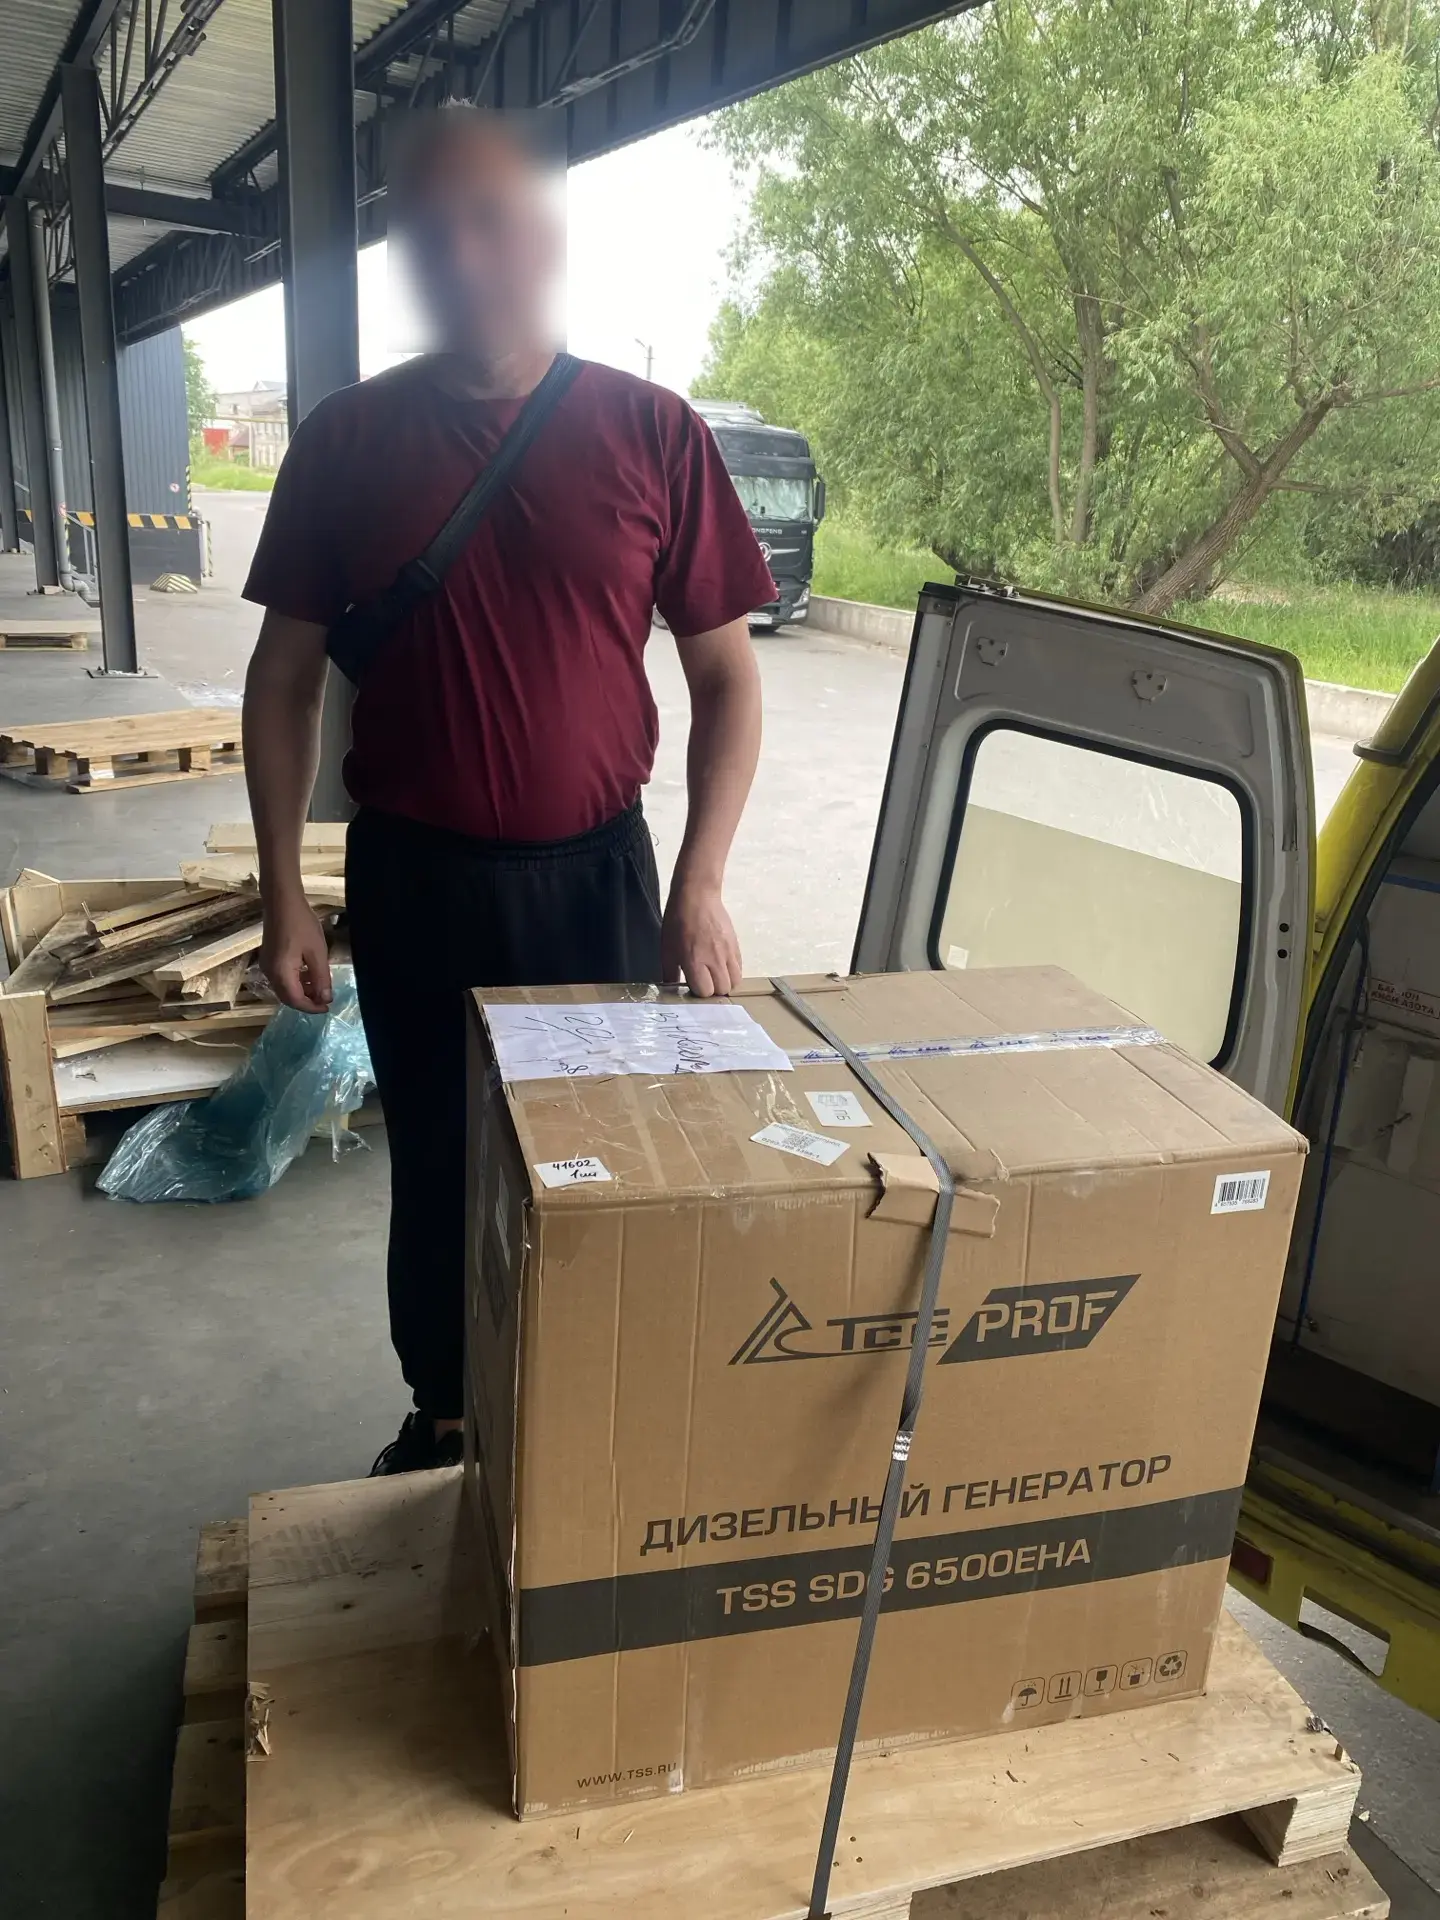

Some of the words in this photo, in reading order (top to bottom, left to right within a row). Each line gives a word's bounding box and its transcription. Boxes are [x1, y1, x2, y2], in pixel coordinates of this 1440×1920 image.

[751, 527, 783, 535] ONGFENG
[552, 1159, 596, 1171] 41602
[975, 1290, 1118, 1343] PROF
[942, 1454, 1172, 1513] ГЕНЕРАТОР
[716, 1579, 796, 1615] TSS
[905, 1538, 1092, 1590] 6500EHA
[577, 1762, 677, 1789] WWW.TSS.RU
